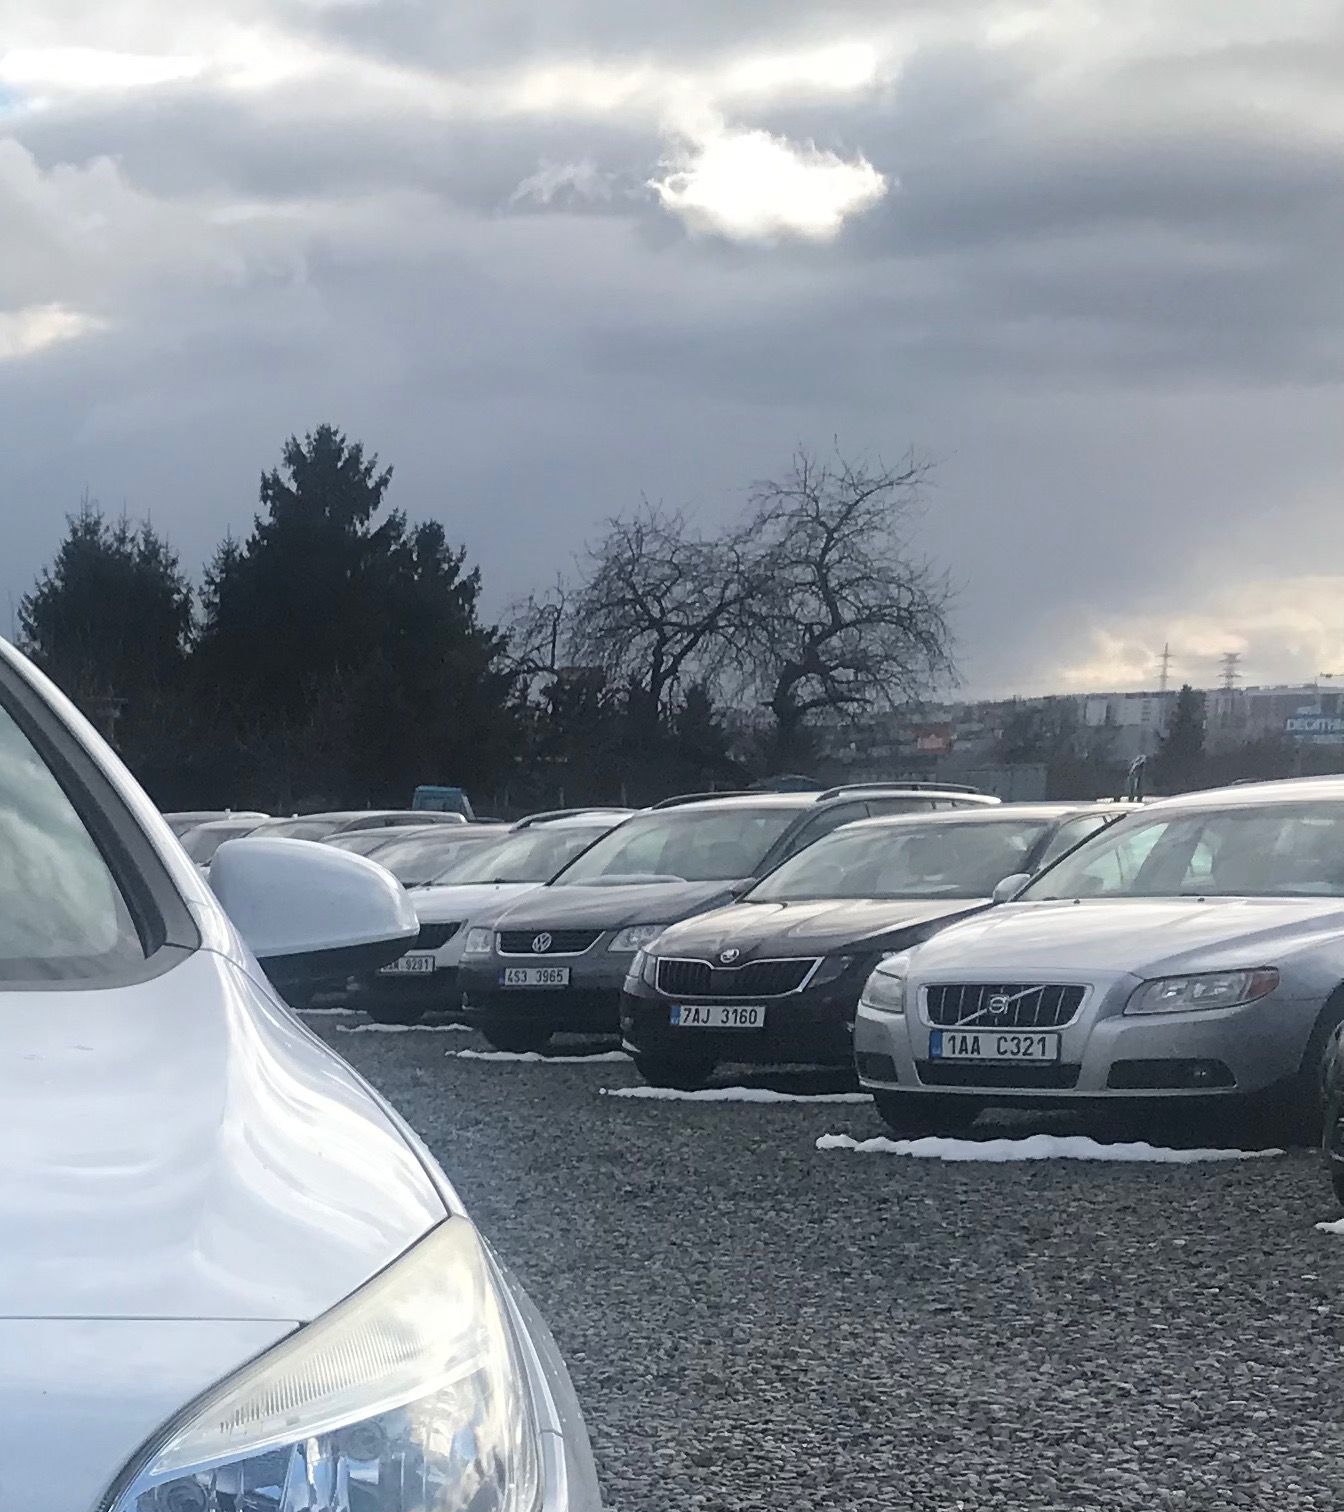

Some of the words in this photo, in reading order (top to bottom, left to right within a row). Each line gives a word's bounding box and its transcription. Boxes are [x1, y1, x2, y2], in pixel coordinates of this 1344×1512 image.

[536, 969, 564, 983] 3965
[683, 1007, 710, 1024] 7AJ
[720, 1008, 758, 1025] 3160
[947, 1035, 981, 1056] 1AA
[996, 1035, 1047, 1057] C321
